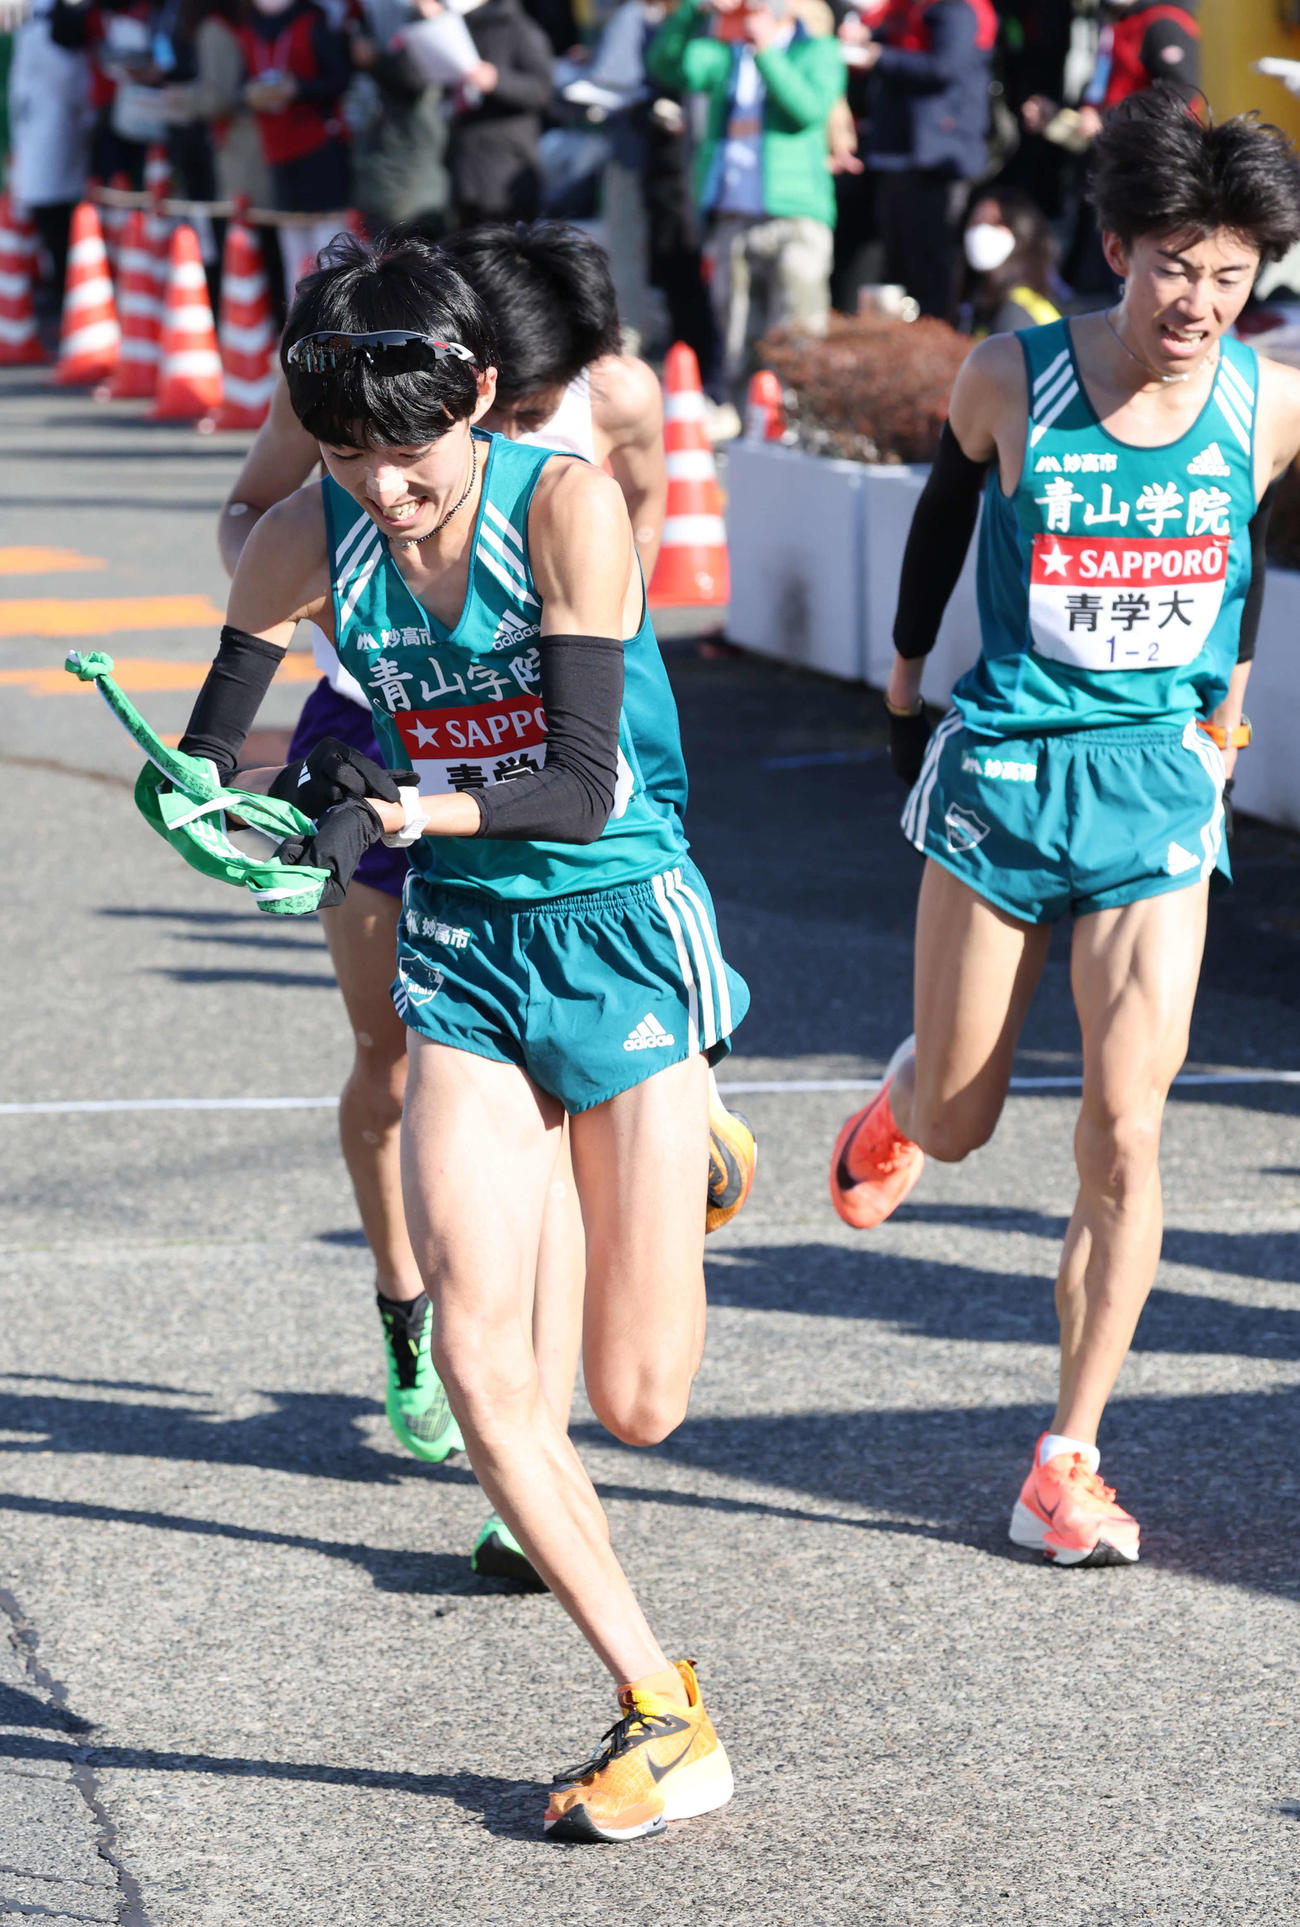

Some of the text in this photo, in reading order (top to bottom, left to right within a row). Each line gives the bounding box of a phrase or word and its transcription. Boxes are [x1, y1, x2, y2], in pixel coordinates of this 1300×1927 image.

[1034, 476, 1232, 537] 青山学院
[1079, 546, 1222, 579] SAPPORO
[1064, 590, 1194, 632] 青学大
[493, 624, 541, 651] adidas
[623, 1033, 675, 1052] adidas
